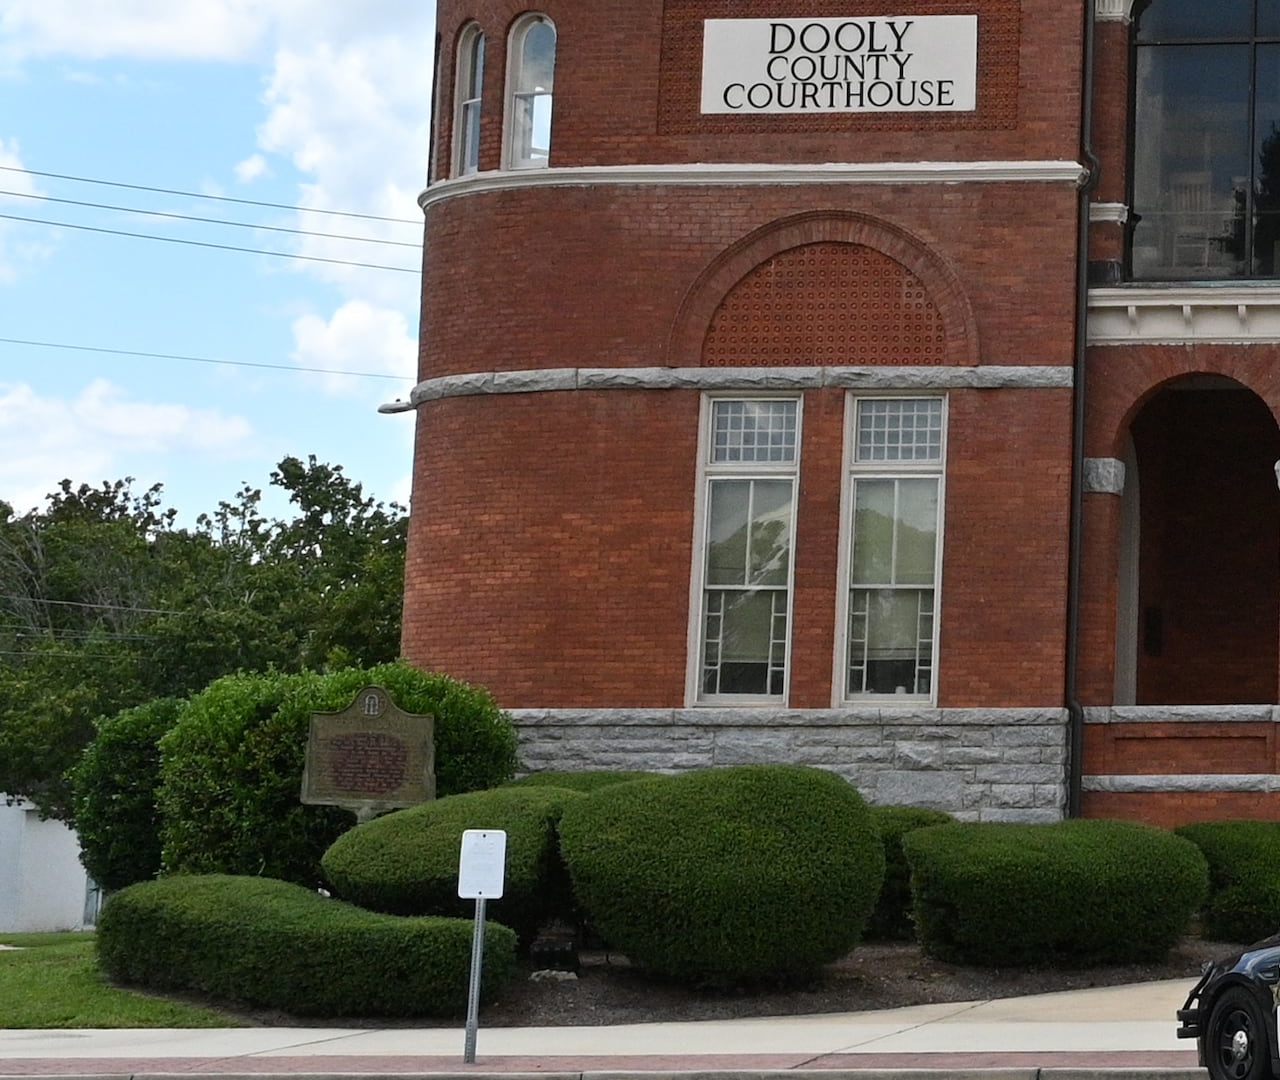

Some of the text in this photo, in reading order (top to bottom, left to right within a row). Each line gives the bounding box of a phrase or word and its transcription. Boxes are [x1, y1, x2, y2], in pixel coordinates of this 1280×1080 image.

[768, 21, 914, 54] DOOLY
[767, 53, 913, 81] COUNTY
[723, 80, 955, 109] COURTHOUSE
